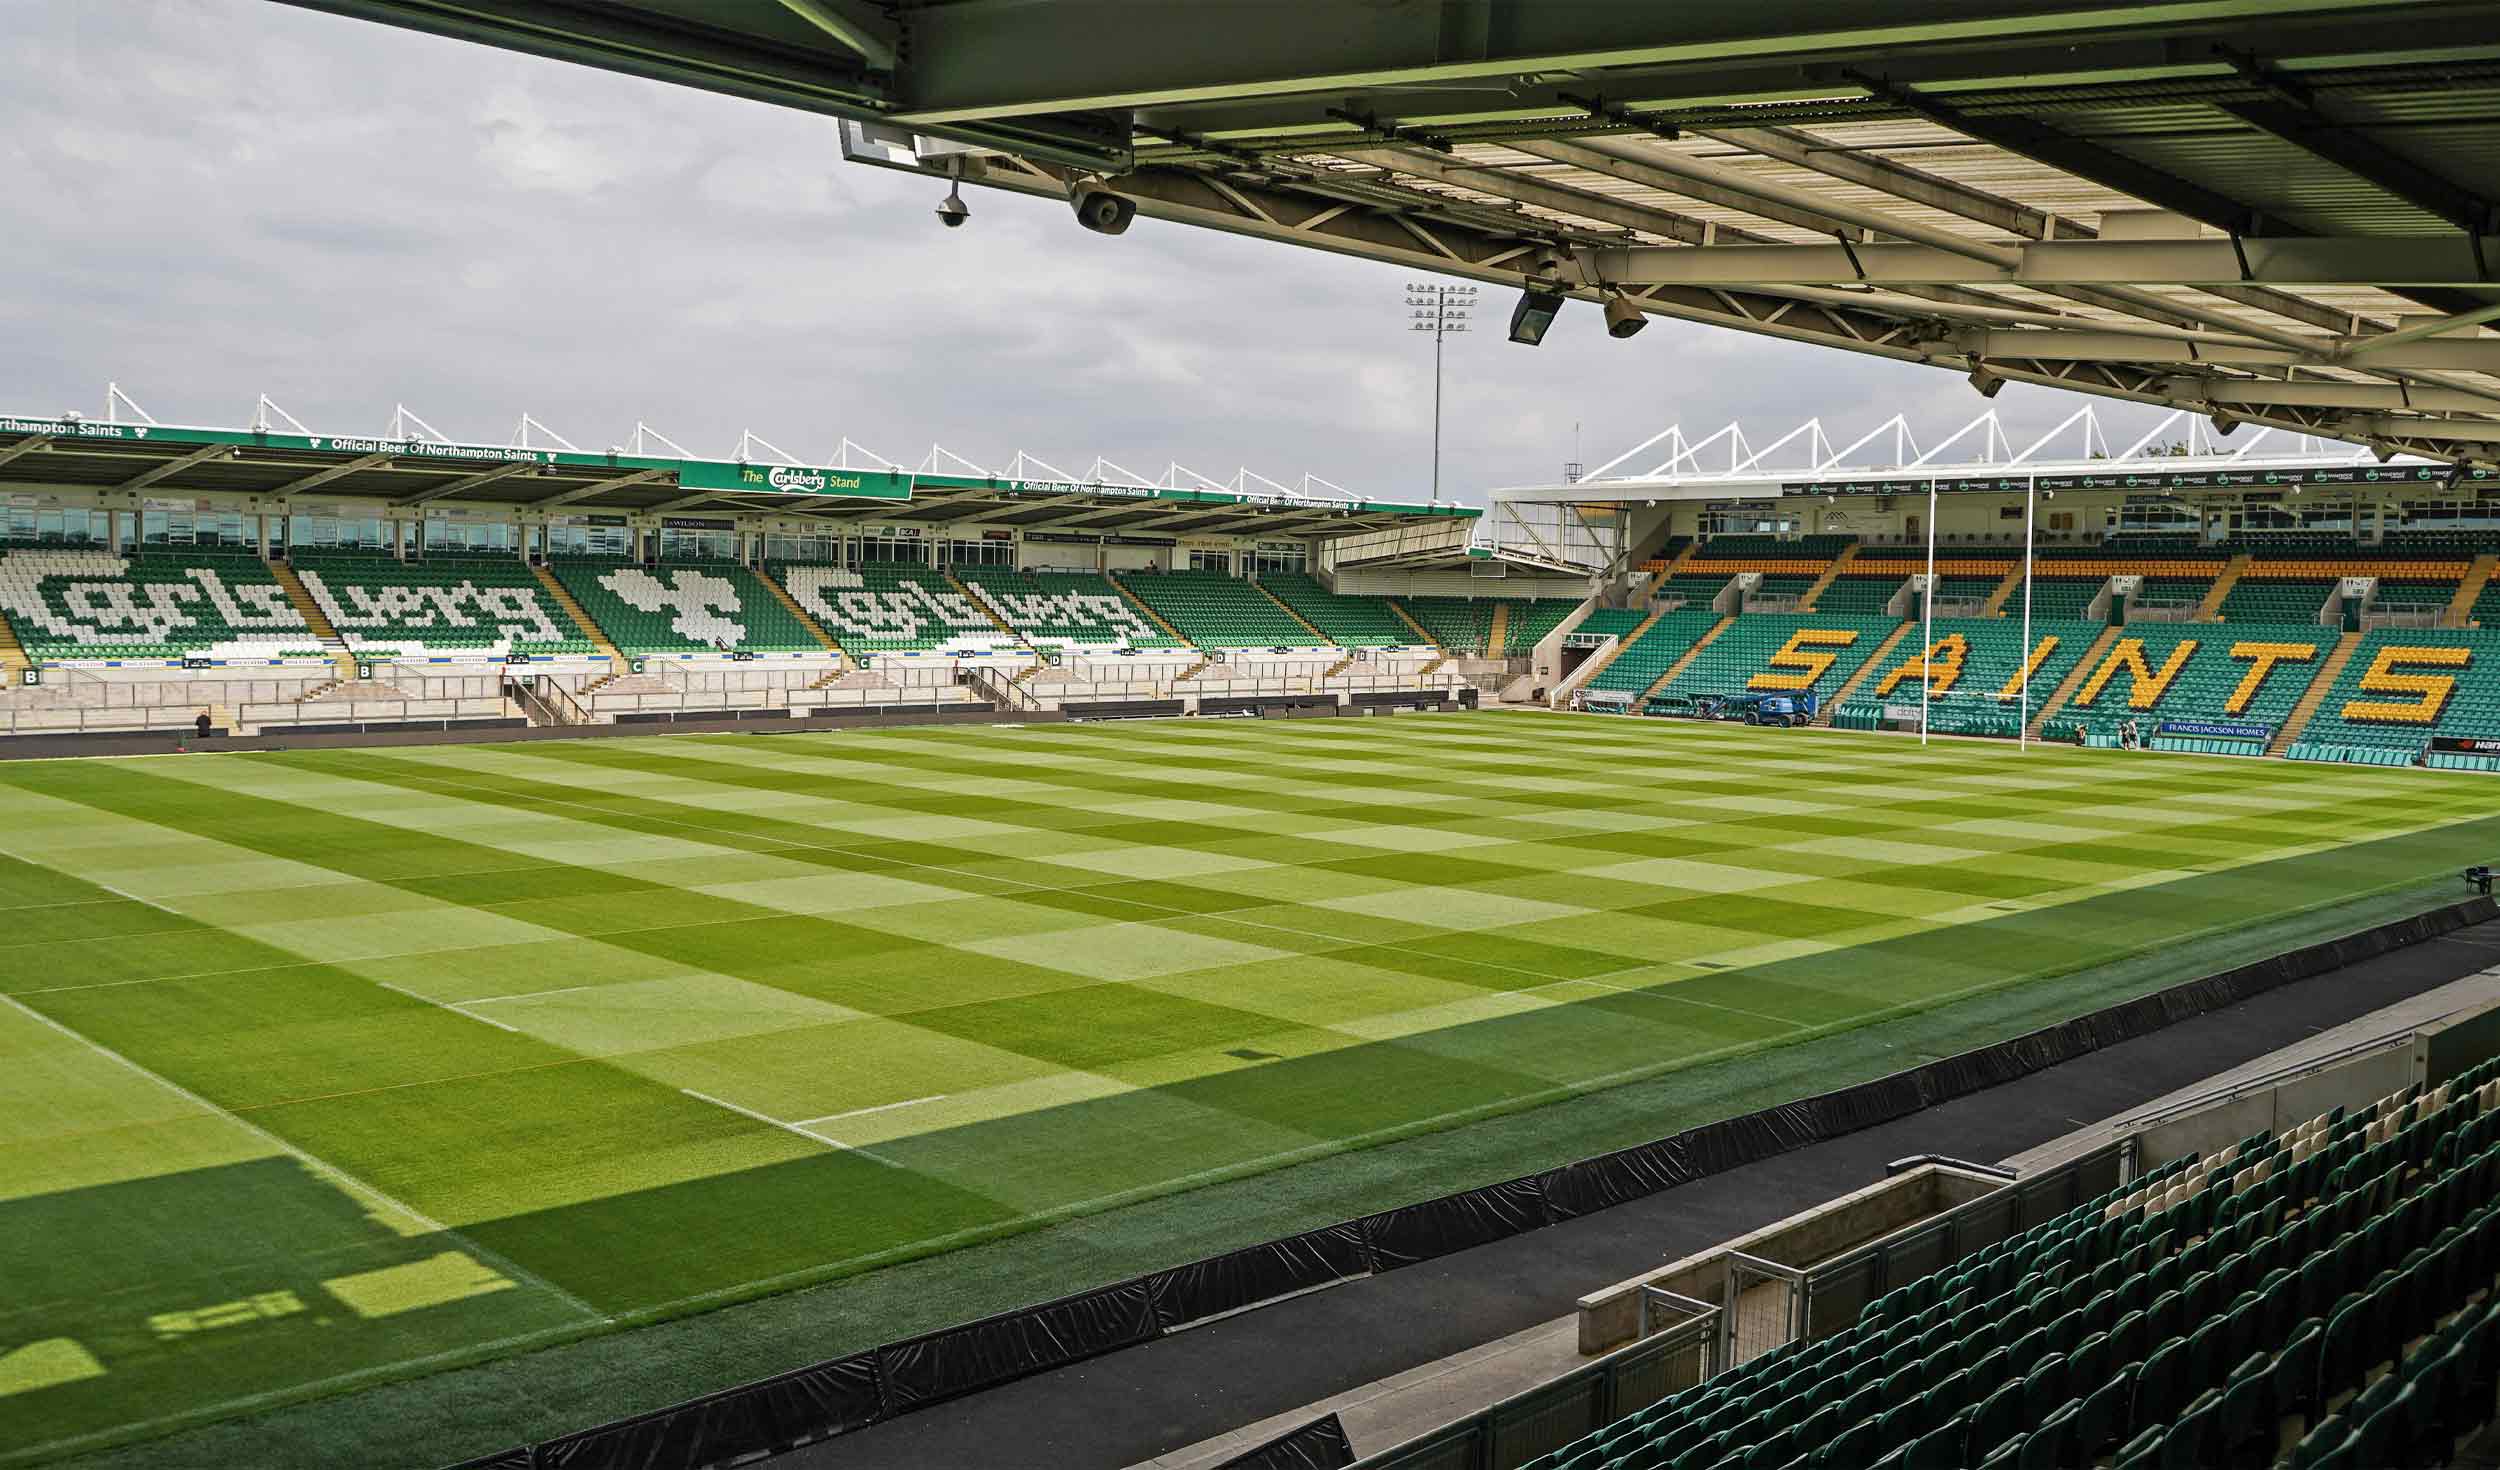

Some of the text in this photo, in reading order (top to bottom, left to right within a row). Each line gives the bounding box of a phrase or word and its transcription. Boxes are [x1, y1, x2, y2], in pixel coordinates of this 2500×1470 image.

[78, 423, 122, 437] Saints
[331, 439, 537, 461] Official Beer Of Northampton Saints
[743, 467, 860, 492] The Carlsberg Stand
[1023, 481, 1050, 491] Official
[1052, 482, 1069, 493] Beer
[1070, 483, 1080, 493] Of
[1127, 487, 1149, 497] Saints
[1246, 495, 1269, 504] Official
[860, 659, 868, 668] C
[1052, 656, 1059, 665] D
[360, 666, 370, 677] B
[632, 661, 642, 672] C
[25, 671, 37, 683] B
[1746, 629, 2472, 722] SAINTS
[2169, 724, 2200, 733] FRANCIS
[2201, 725, 2234, 735] JACKSON
